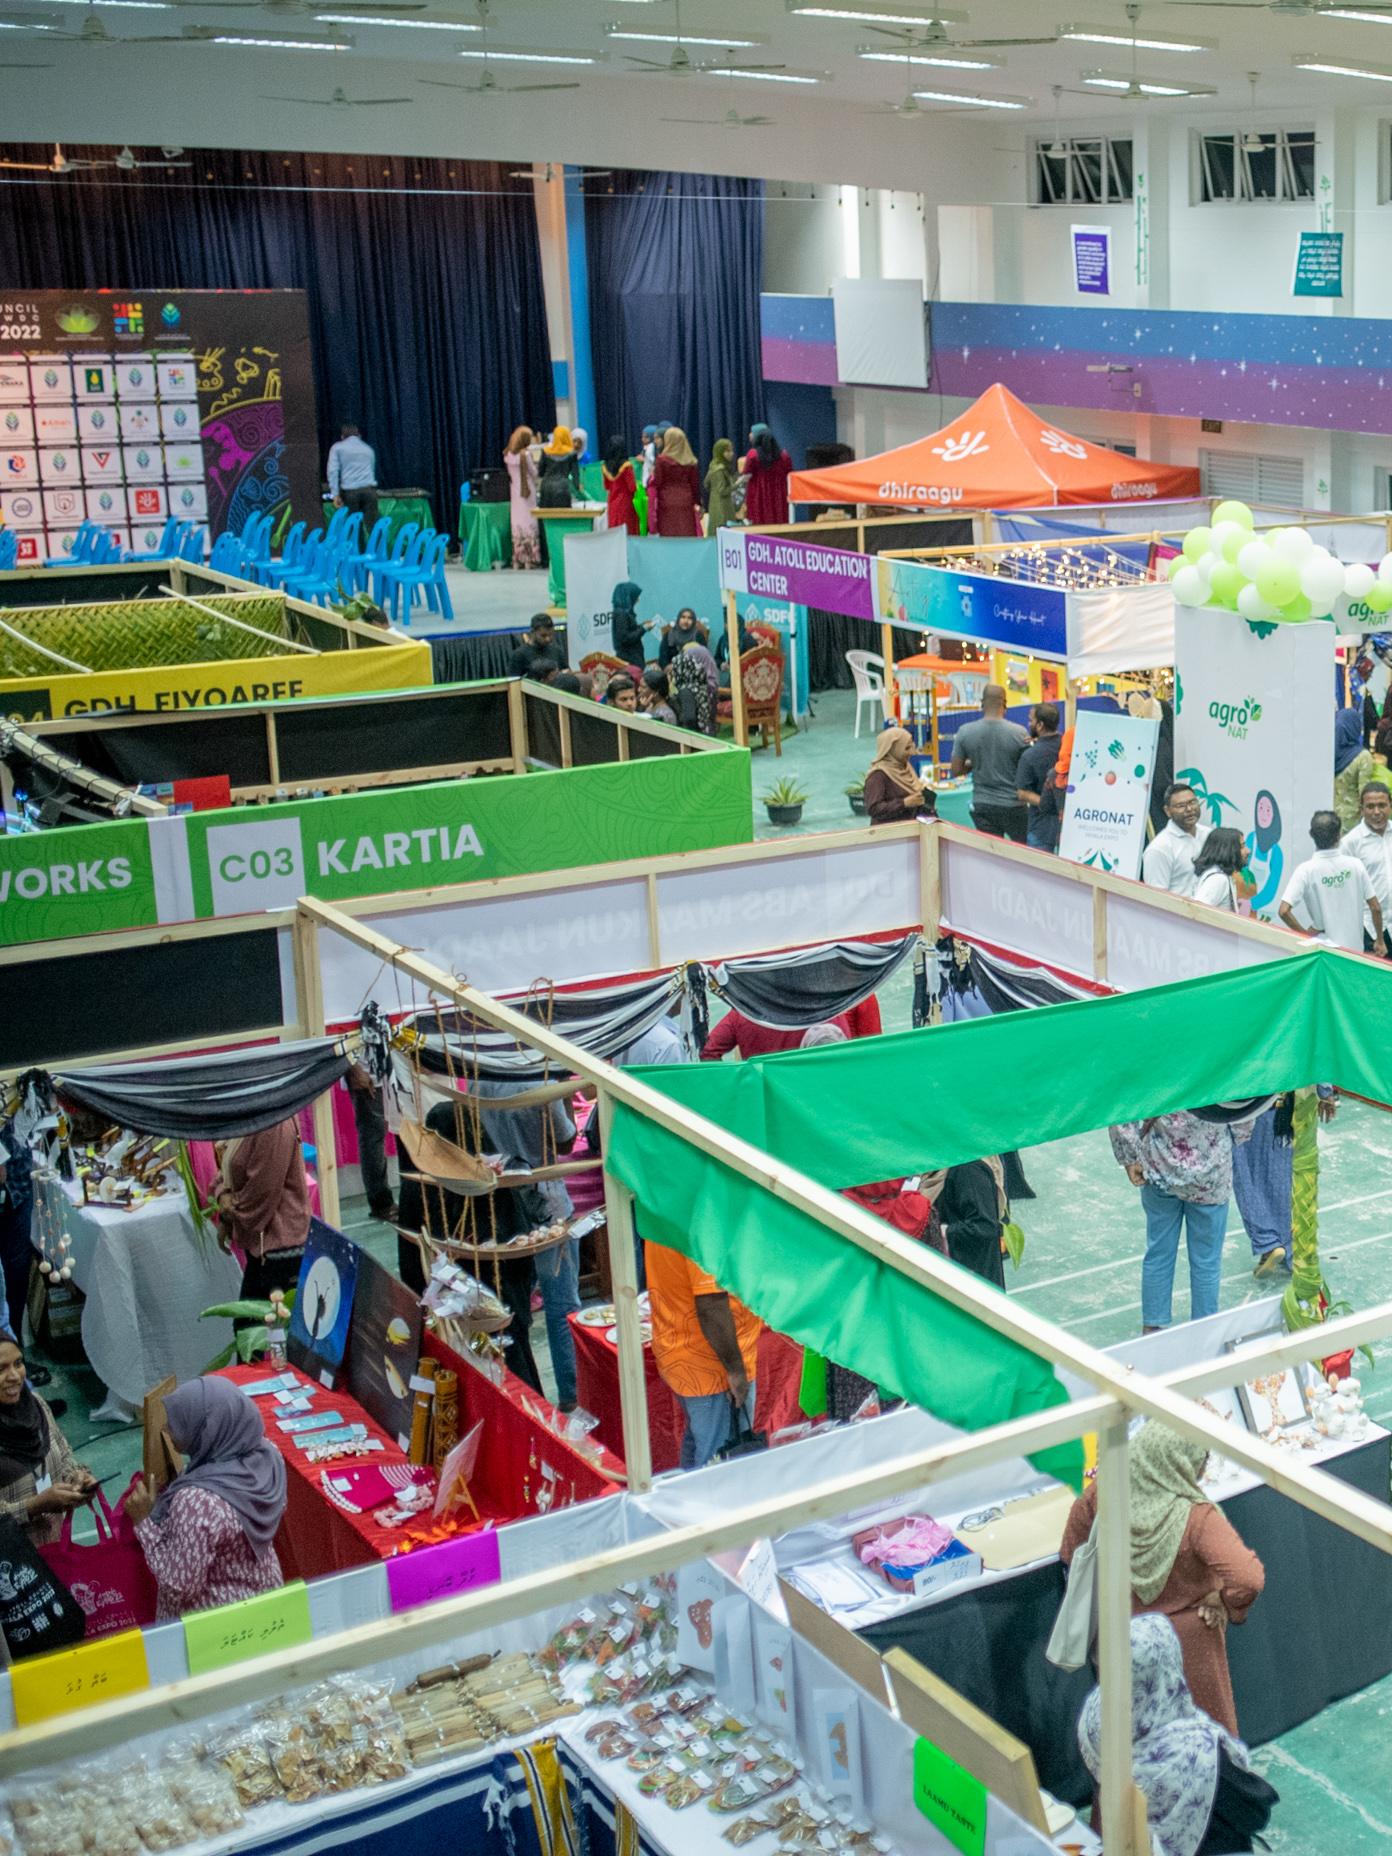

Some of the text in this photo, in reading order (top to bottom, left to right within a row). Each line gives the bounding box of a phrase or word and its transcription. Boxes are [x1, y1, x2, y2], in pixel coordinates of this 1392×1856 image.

[0, 304, 39, 313] NCIL
[0, 325, 41, 340] 2022
[878, 482, 964, 505] dhiraagu
[1111, 482, 1158, 500] dhiraagu
[725, 550, 743, 570] B01
[748, 542, 868, 580] GDH. ATOLL EDUCATION
[750, 570, 788, 596] CENTER
[1208, 700, 1247, 728] agro
[1227, 725, 1248, 740] NAT
[1074, 808, 1134, 826] AGRONAT
[317, 824, 485, 877] KARTIA
[220, 848, 294, 883] C03
[951, 1807, 976, 1835] TASTE
